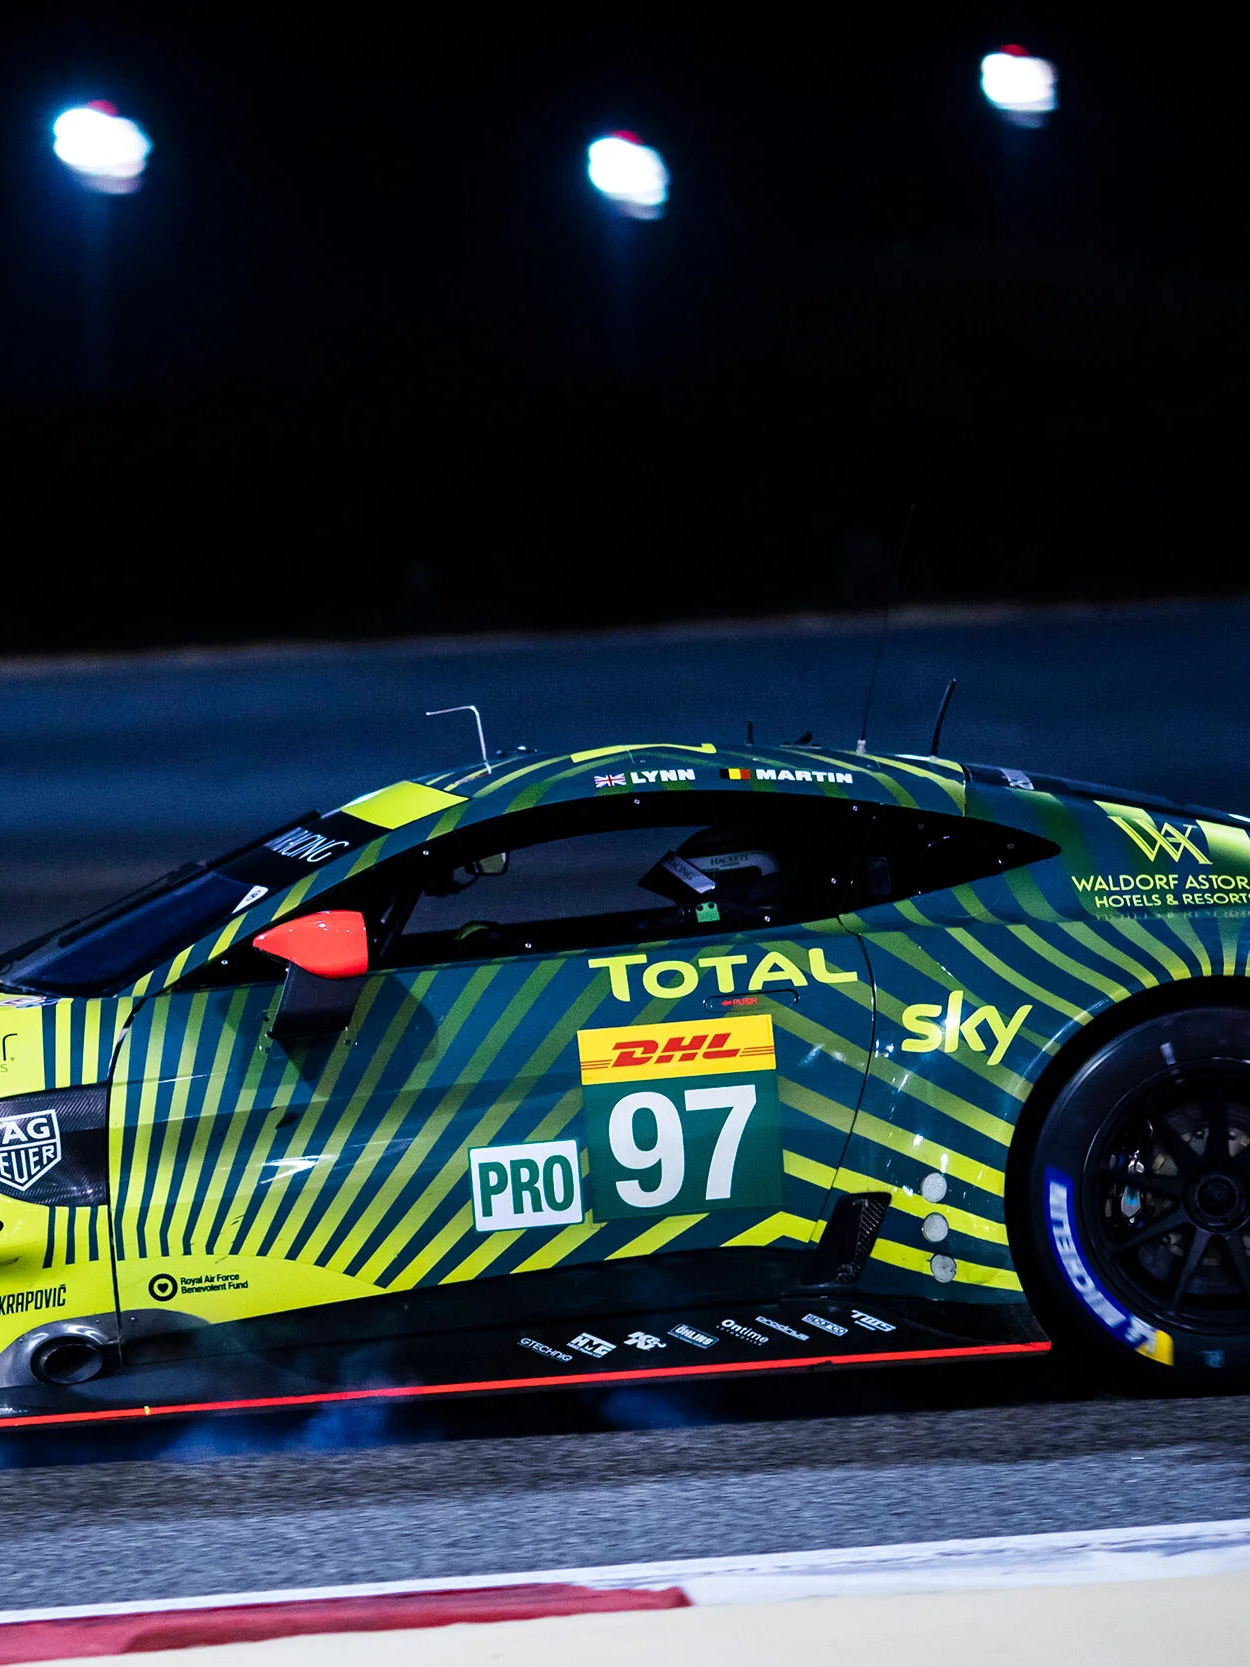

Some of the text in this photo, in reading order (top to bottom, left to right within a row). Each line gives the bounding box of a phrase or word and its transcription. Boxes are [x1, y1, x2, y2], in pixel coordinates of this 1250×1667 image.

[630, 769, 696, 784] LYNN
[756, 769, 854, 784] MARTIN
[1071, 874, 1179, 892] WALDORF
[1095, 894, 1162, 908] HOTELS
[1166, 894, 1179, 905] &
[588, 948, 858, 1002] TOTAL
[732, 997, 758, 1006] PUSH
[901, 991, 1033, 1066] sky
[611, 1032, 741, 1068] DHL
[608, 1084, 757, 1208] 97
[478, 1154, 575, 1217] PRO
[180, 1273, 240, 1286] Royal Air Force
[181, 1280, 248, 1294] Benevolent Fund
